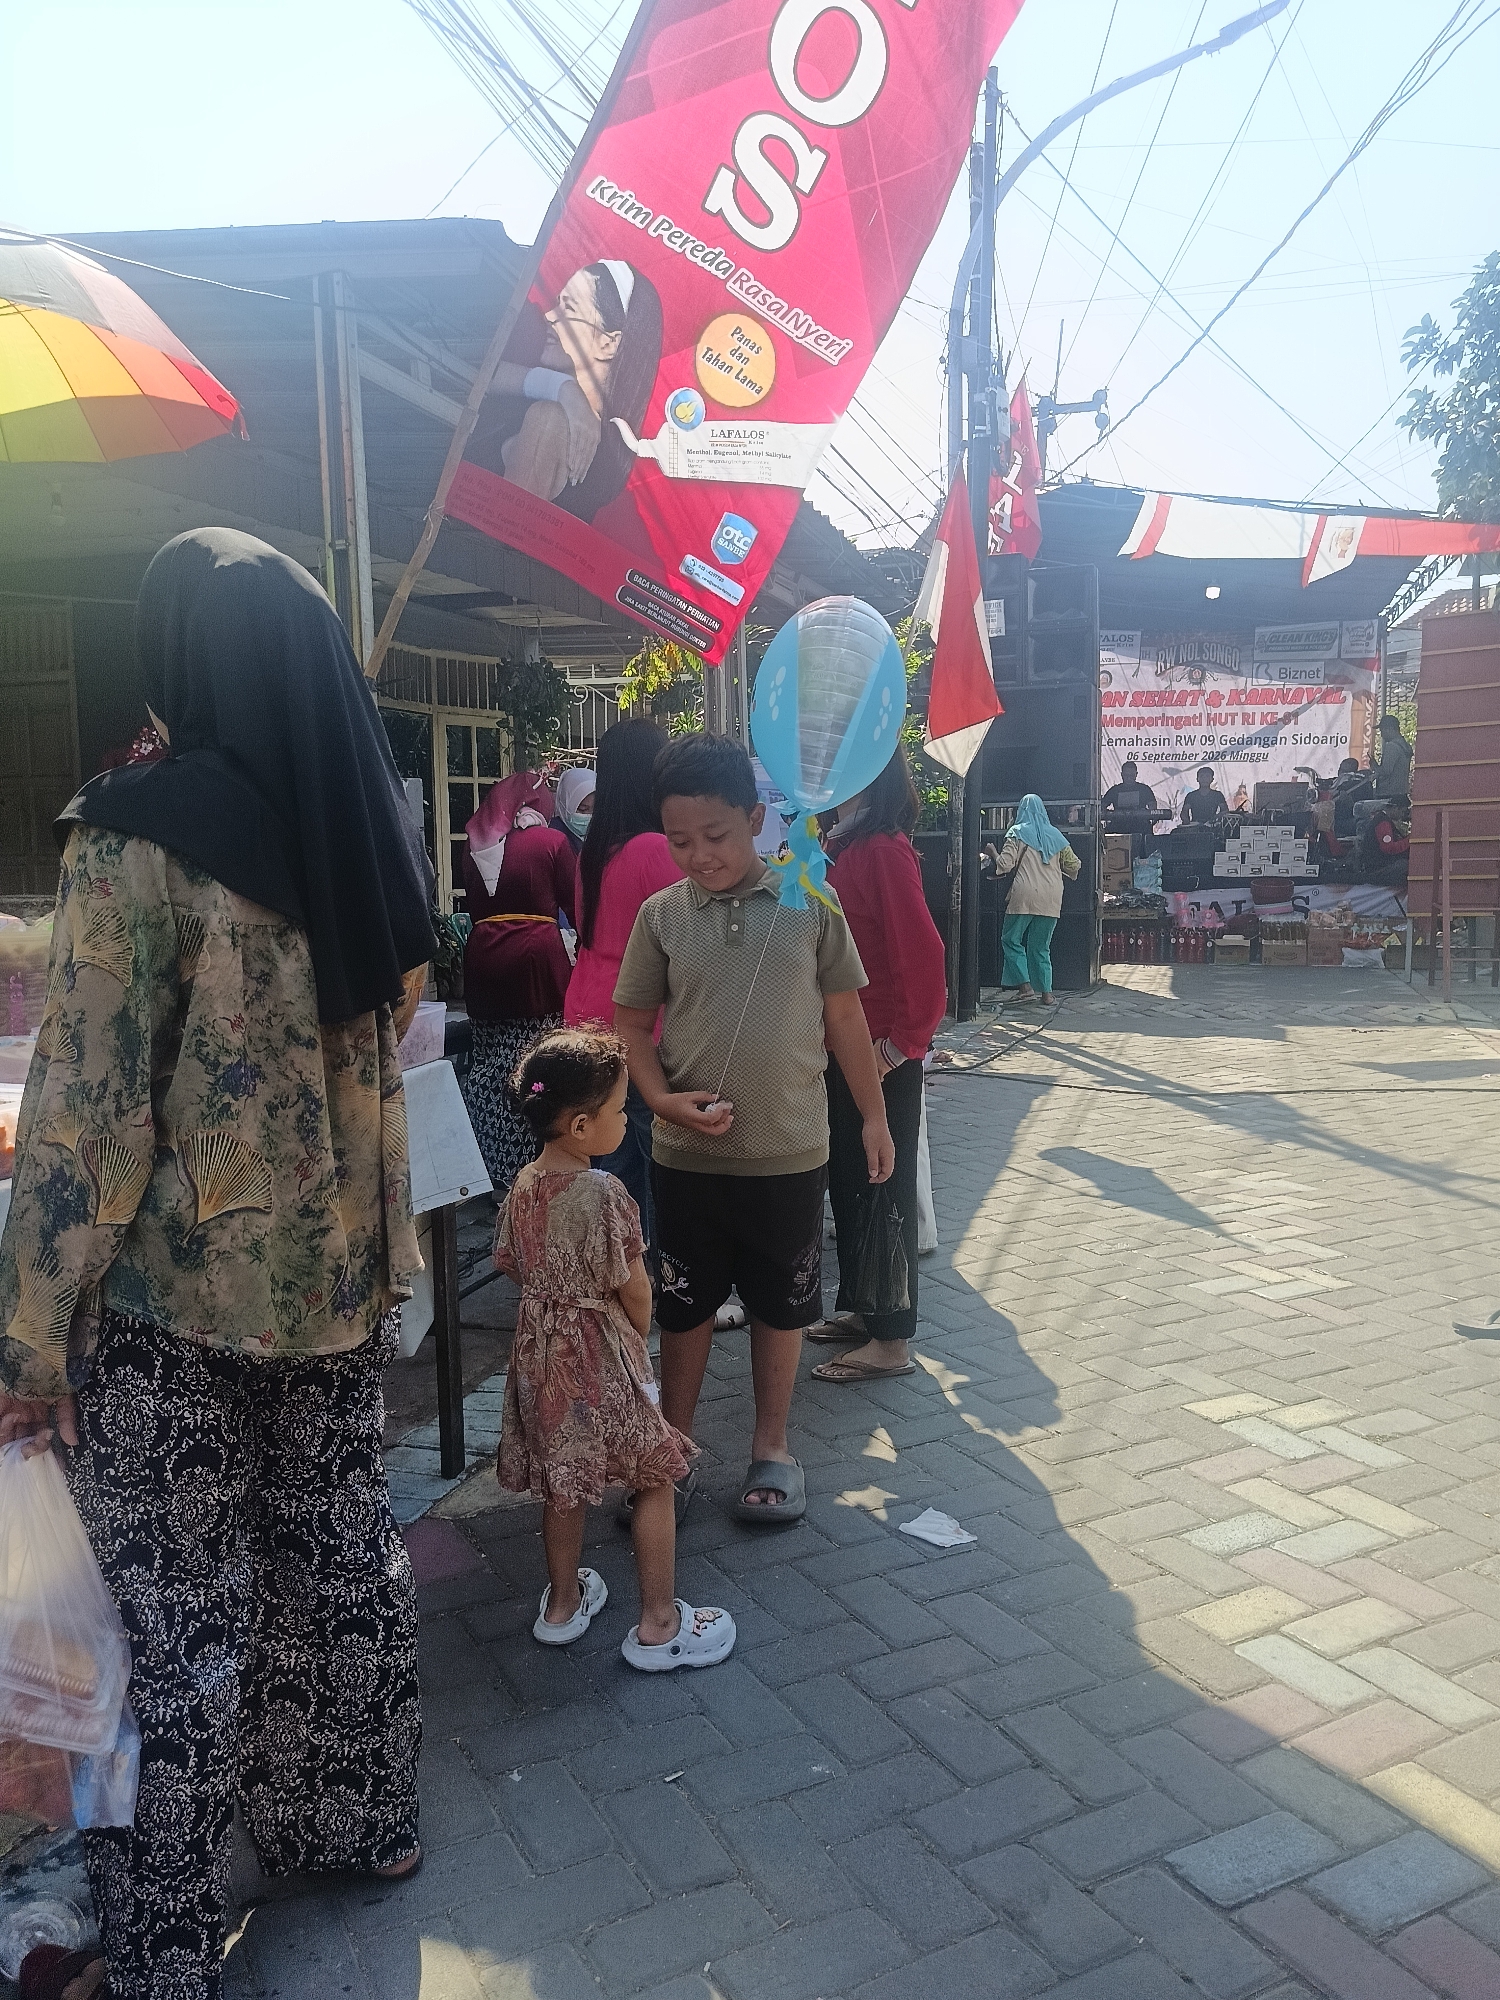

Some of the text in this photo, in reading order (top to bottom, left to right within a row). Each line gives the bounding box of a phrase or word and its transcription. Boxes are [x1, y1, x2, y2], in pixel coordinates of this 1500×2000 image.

[586, 177, 853, 364] Krim Pereda Rasa Nyeri
[730, 325, 763, 355] Panas
[729, 345, 750, 366] dan
[701, 347, 764, 395] Tahan Lama
[711, 429, 765, 439] LAFALOS
[717, 537, 746, 558] SANBE
[633, 574, 720, 631] BACA PERINGATAN PERHATIAN
[1100, 634, 1134, 643] ALOS
[1269, 632, 1303, 643] CLEAN
[1156, 641, 1240, 676] RW NOL SONGO
[1279, 667, 1321, 680] Biznet
[1129, 689, 1206, 708] SEHAT
[1205, 690, 1225, 708] &
[1226, 687, 1346, 706] KARNAVAL
[1101, 712, 1202, 730] Memperingati
[1206, 712, 1239, 726] HUT
[1241, 711, 1256, 726] RI
[1100, 733, 1348, 748] Lemahasin RW 09 Gedangan Sidoarjo
[1126, 750, 1269, 763] 06 September 2026 Minggu
